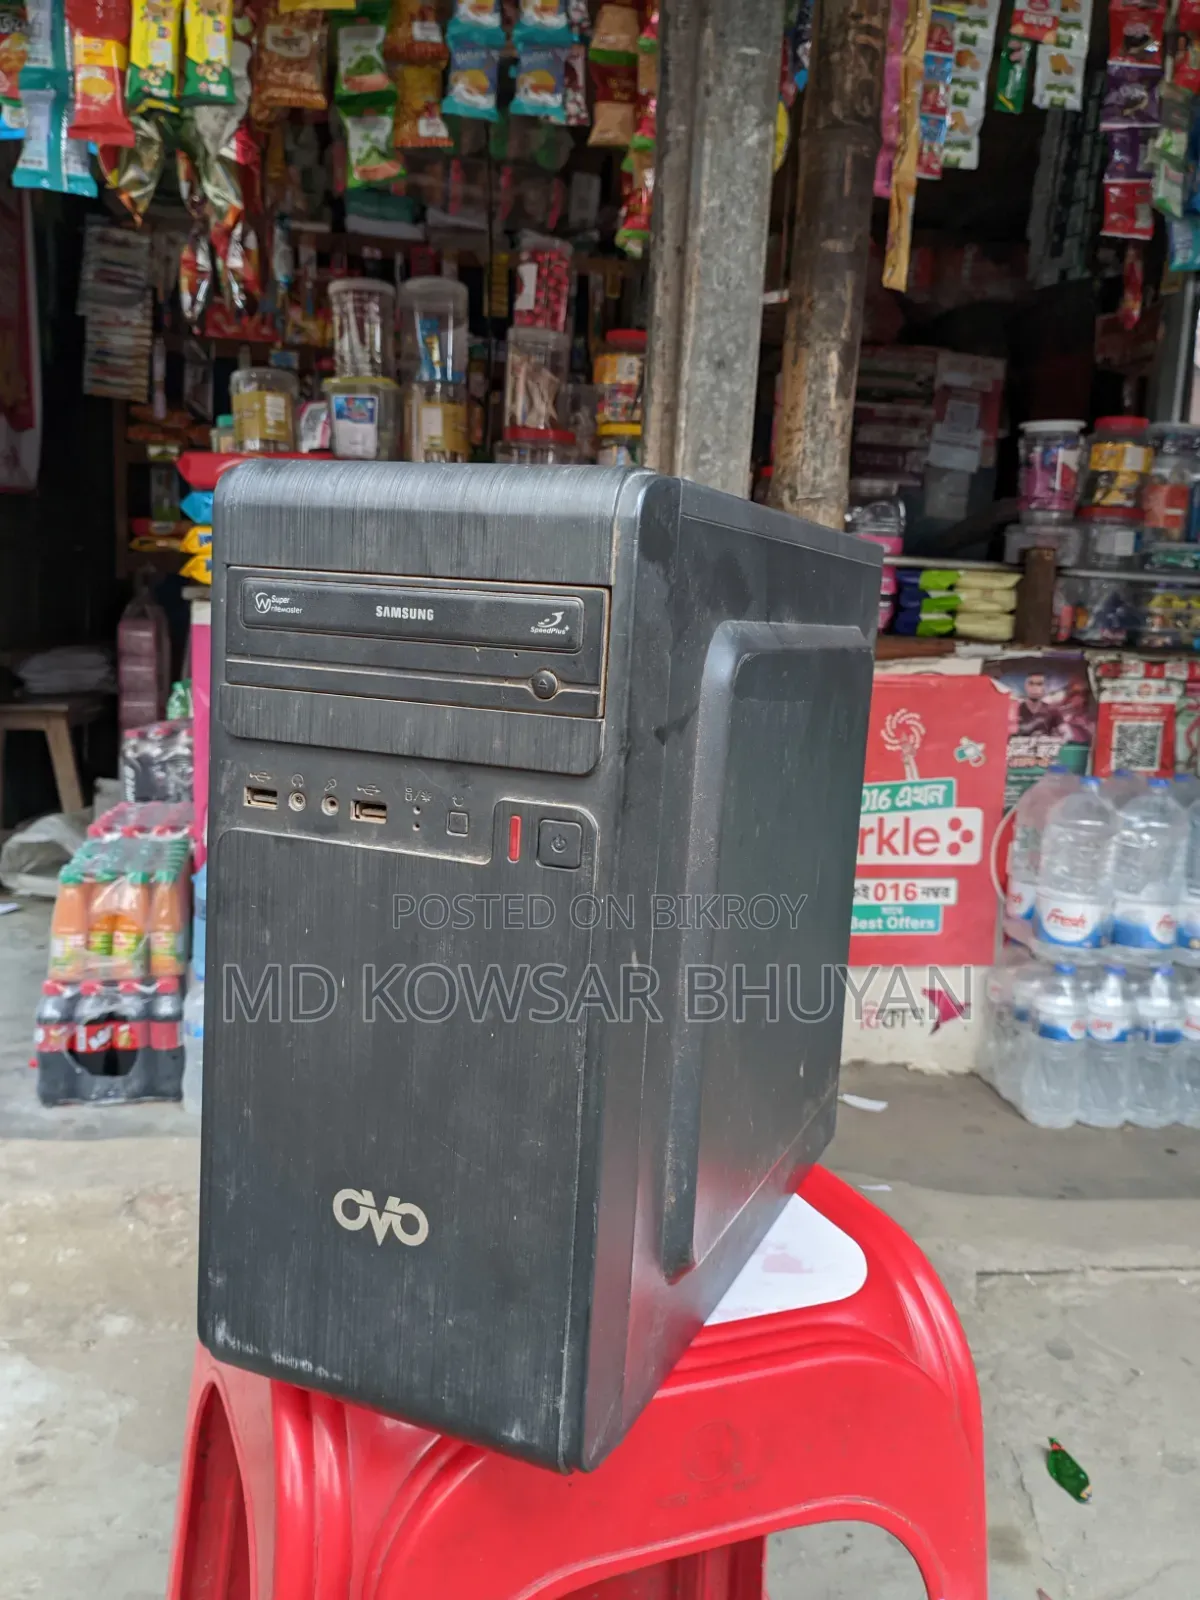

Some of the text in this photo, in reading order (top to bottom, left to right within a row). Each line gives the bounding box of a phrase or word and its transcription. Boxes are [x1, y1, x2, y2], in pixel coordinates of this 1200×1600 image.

[271, 594, 290, 605] Super
[375, 605, 434, 621] SAMSUNG
[895, 784, 948, 808] এখন
[873, 882, 919, 902] 016
[886, 916, 935, 930] Offers
[1046, 908, 1088, 929] Fresh
[332, 1188, 429, 1247] OVO
